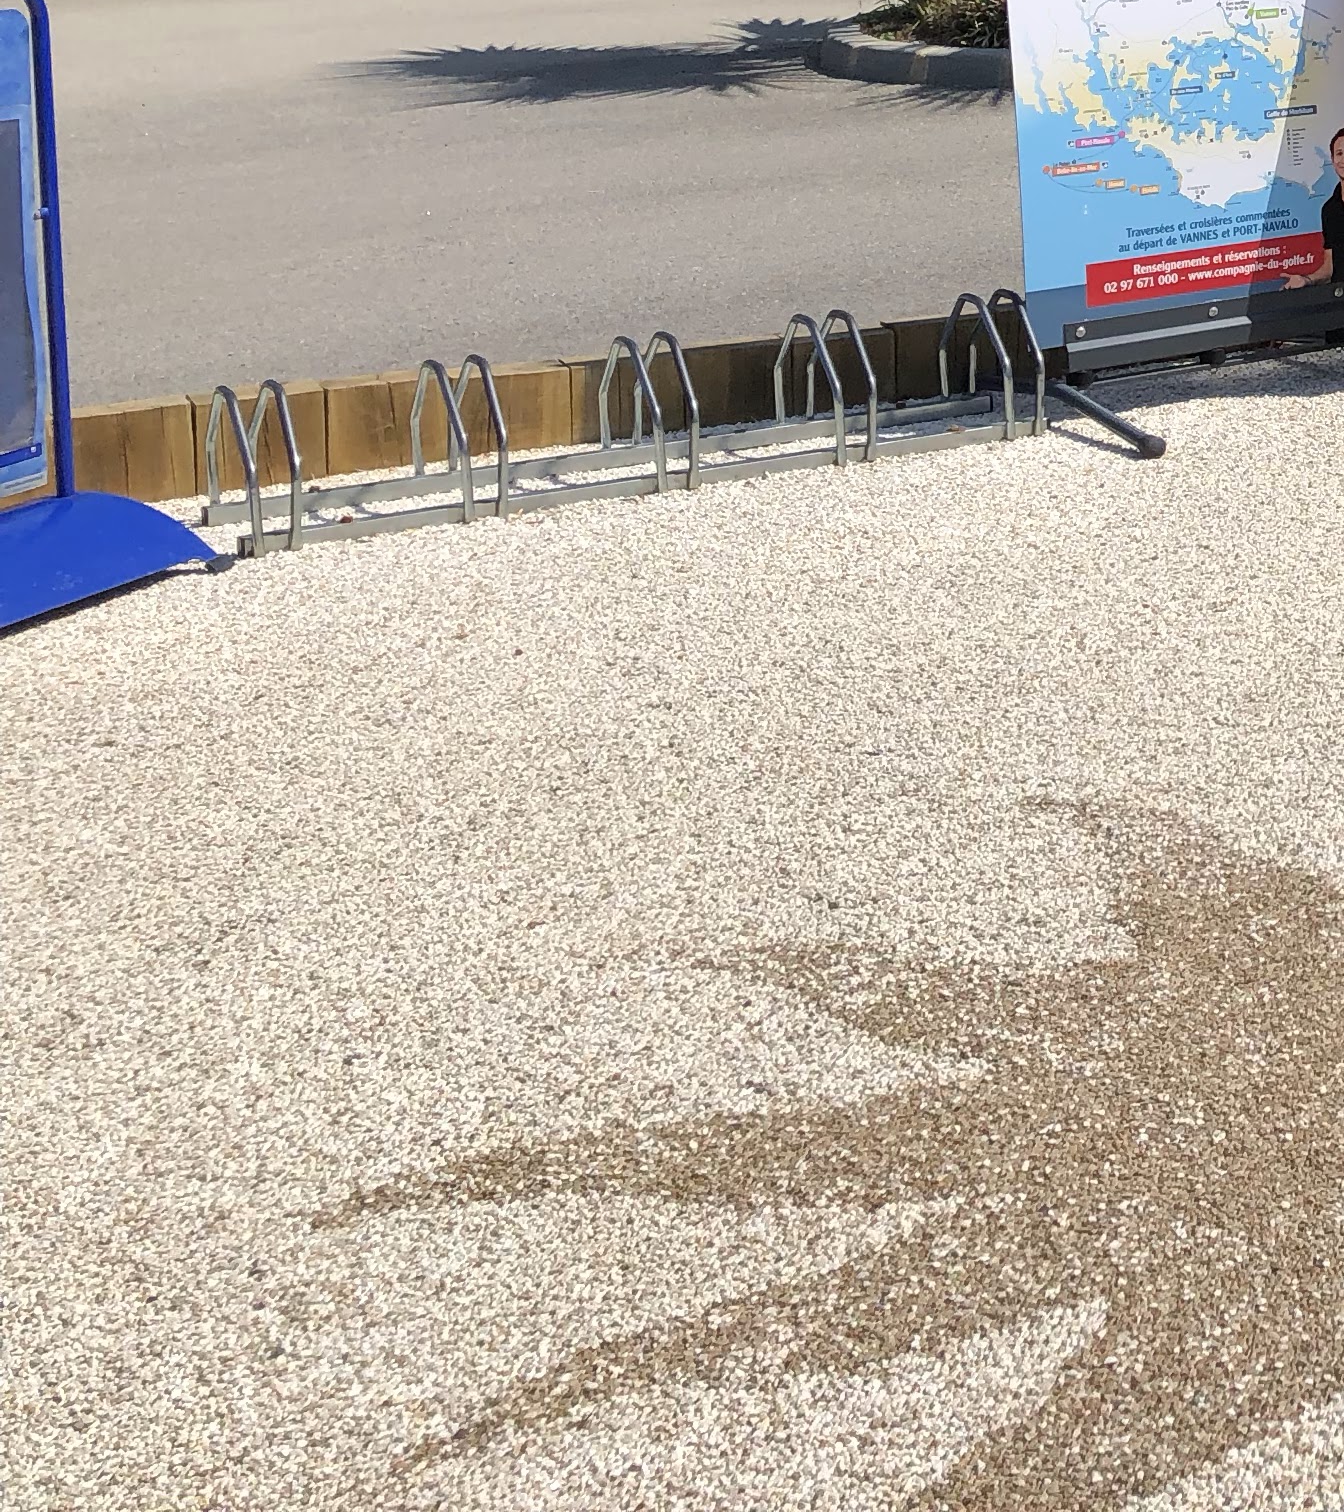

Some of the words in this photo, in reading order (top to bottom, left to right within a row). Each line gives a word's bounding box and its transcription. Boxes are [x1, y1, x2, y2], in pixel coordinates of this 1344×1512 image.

[1118, 243, 1130, 253] au
[1133, 237, 1163, 253] départ
[1165, 235, 1178, 246] de
[1179, 230, 1219, 244] VANNES
[1220, 228, 1231, 240] et
[1232, 217, 1299, 237] PORT-NAVALO
[1125, 222, 1175, 238] Traversées
[1177, 220, 1187, 231] et
[1189, 216, 1233, 230] croisières
[1235, 208, 1291, 224] commentées
[1103, 281, 1118, 294] 02
[1119, 279, 1133, 292] 97
[1136, 277, 1155, 289] 671
[1157, 274, 1179, 286] 000
[1188, 253, 1315, 283] www.compagnie-du-golfe.fr
[1133, 256, 1211, 276] Renseignements
[1212, 254, 1223, 265] et
[1224, 245, 1281, 262] réservations
